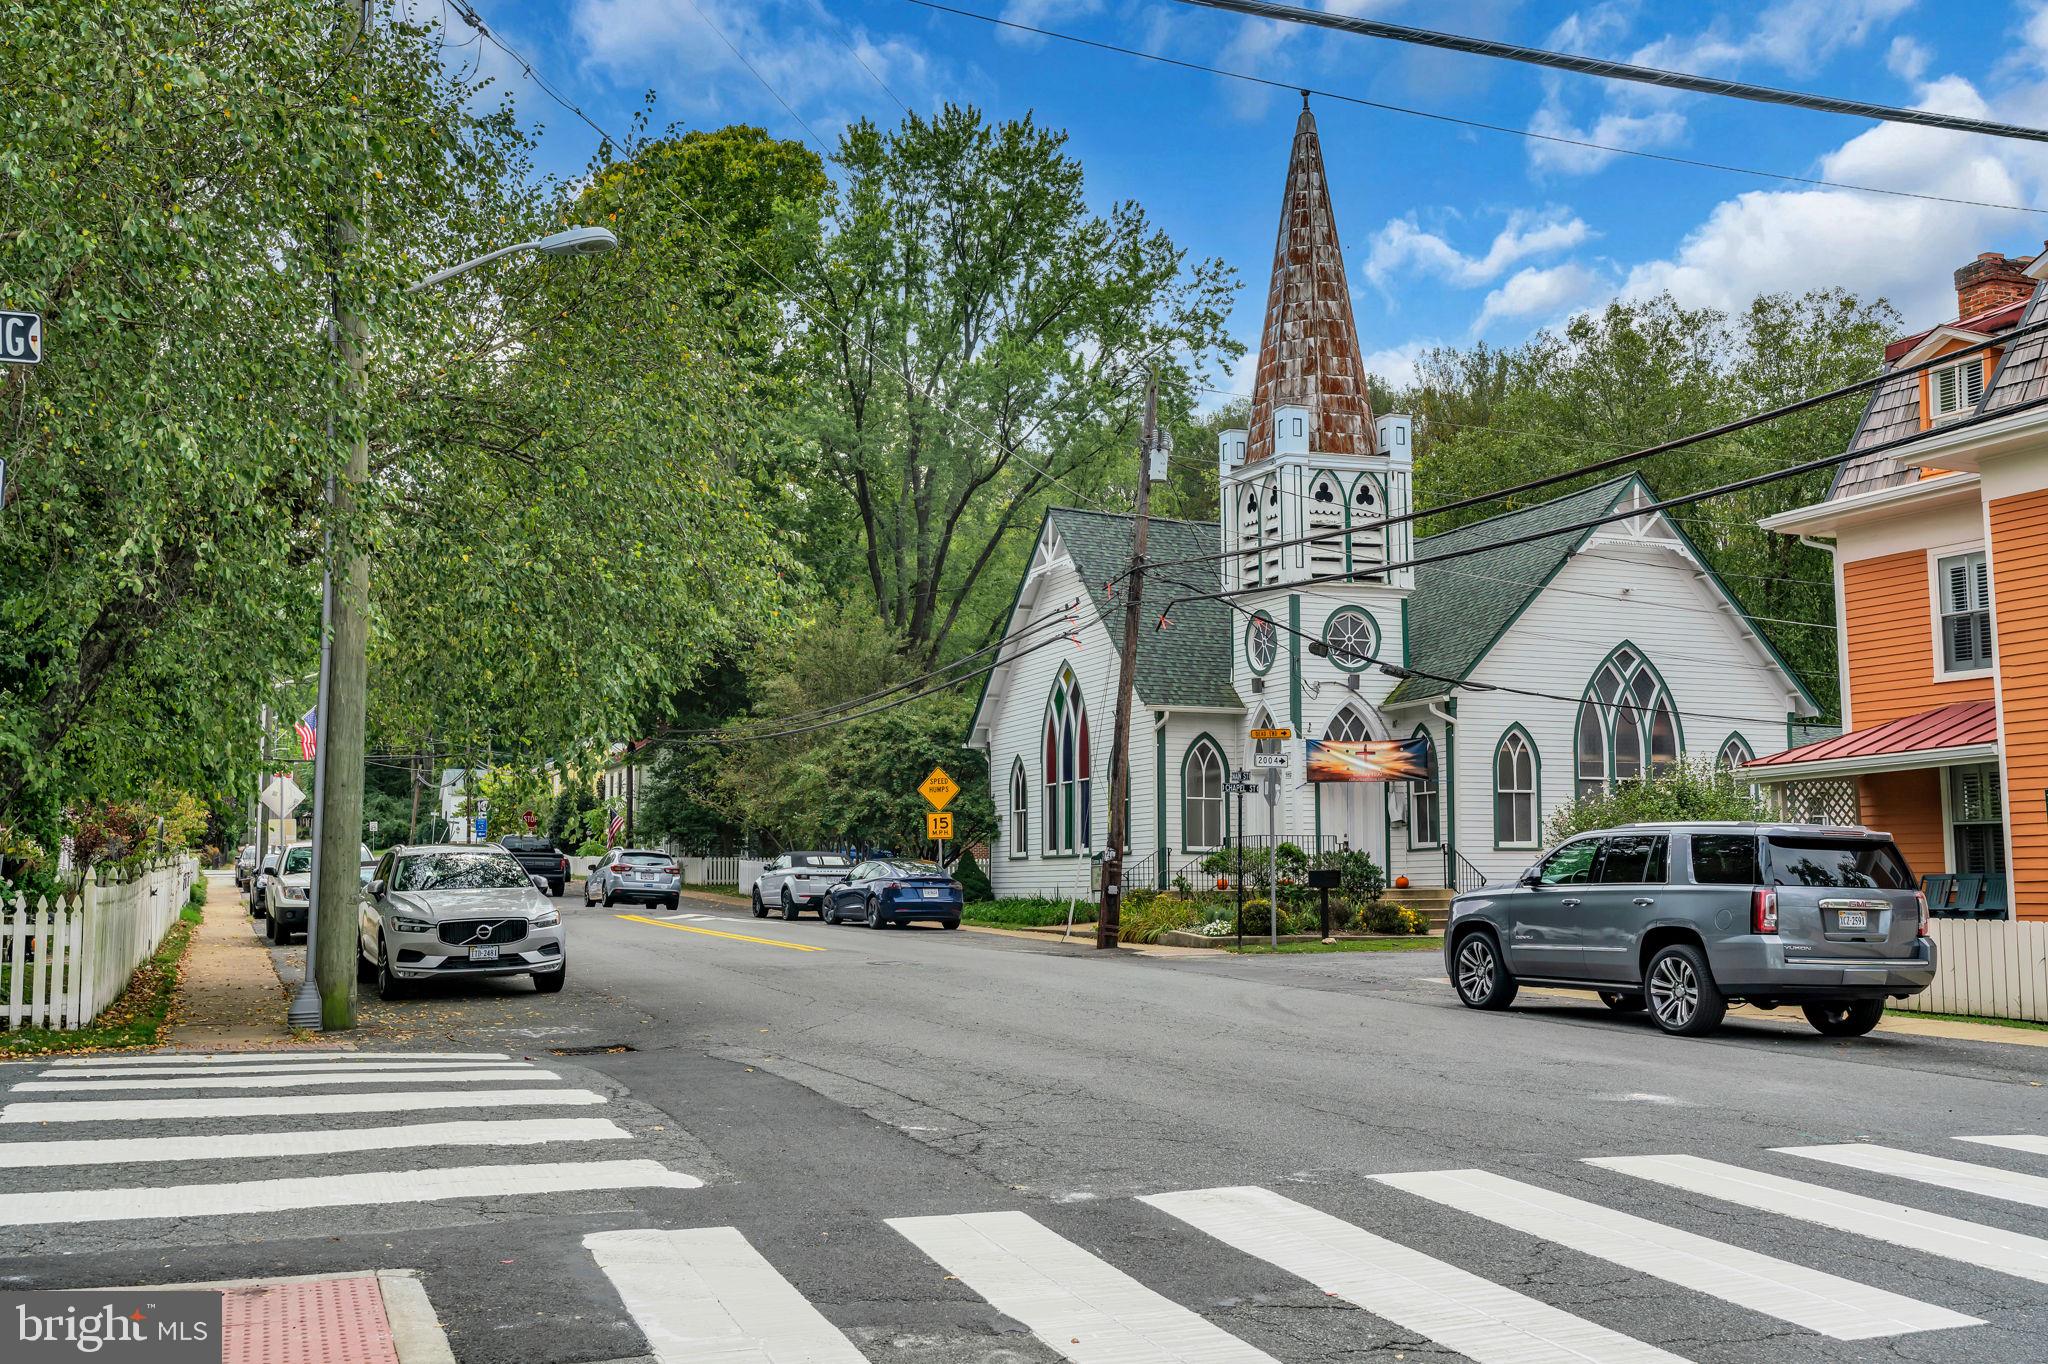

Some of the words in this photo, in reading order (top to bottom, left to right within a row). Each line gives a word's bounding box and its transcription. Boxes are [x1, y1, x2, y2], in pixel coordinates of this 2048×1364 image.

[0, 317, 24, 357] G
[1258, 756, 1278, 764] 2004
[930, 777, 949, 785] SPEED
[929, 785, 949, 793] HUMPS
[524, 815, 538, 823] STOP
[932, 817, 949, 830] 15
